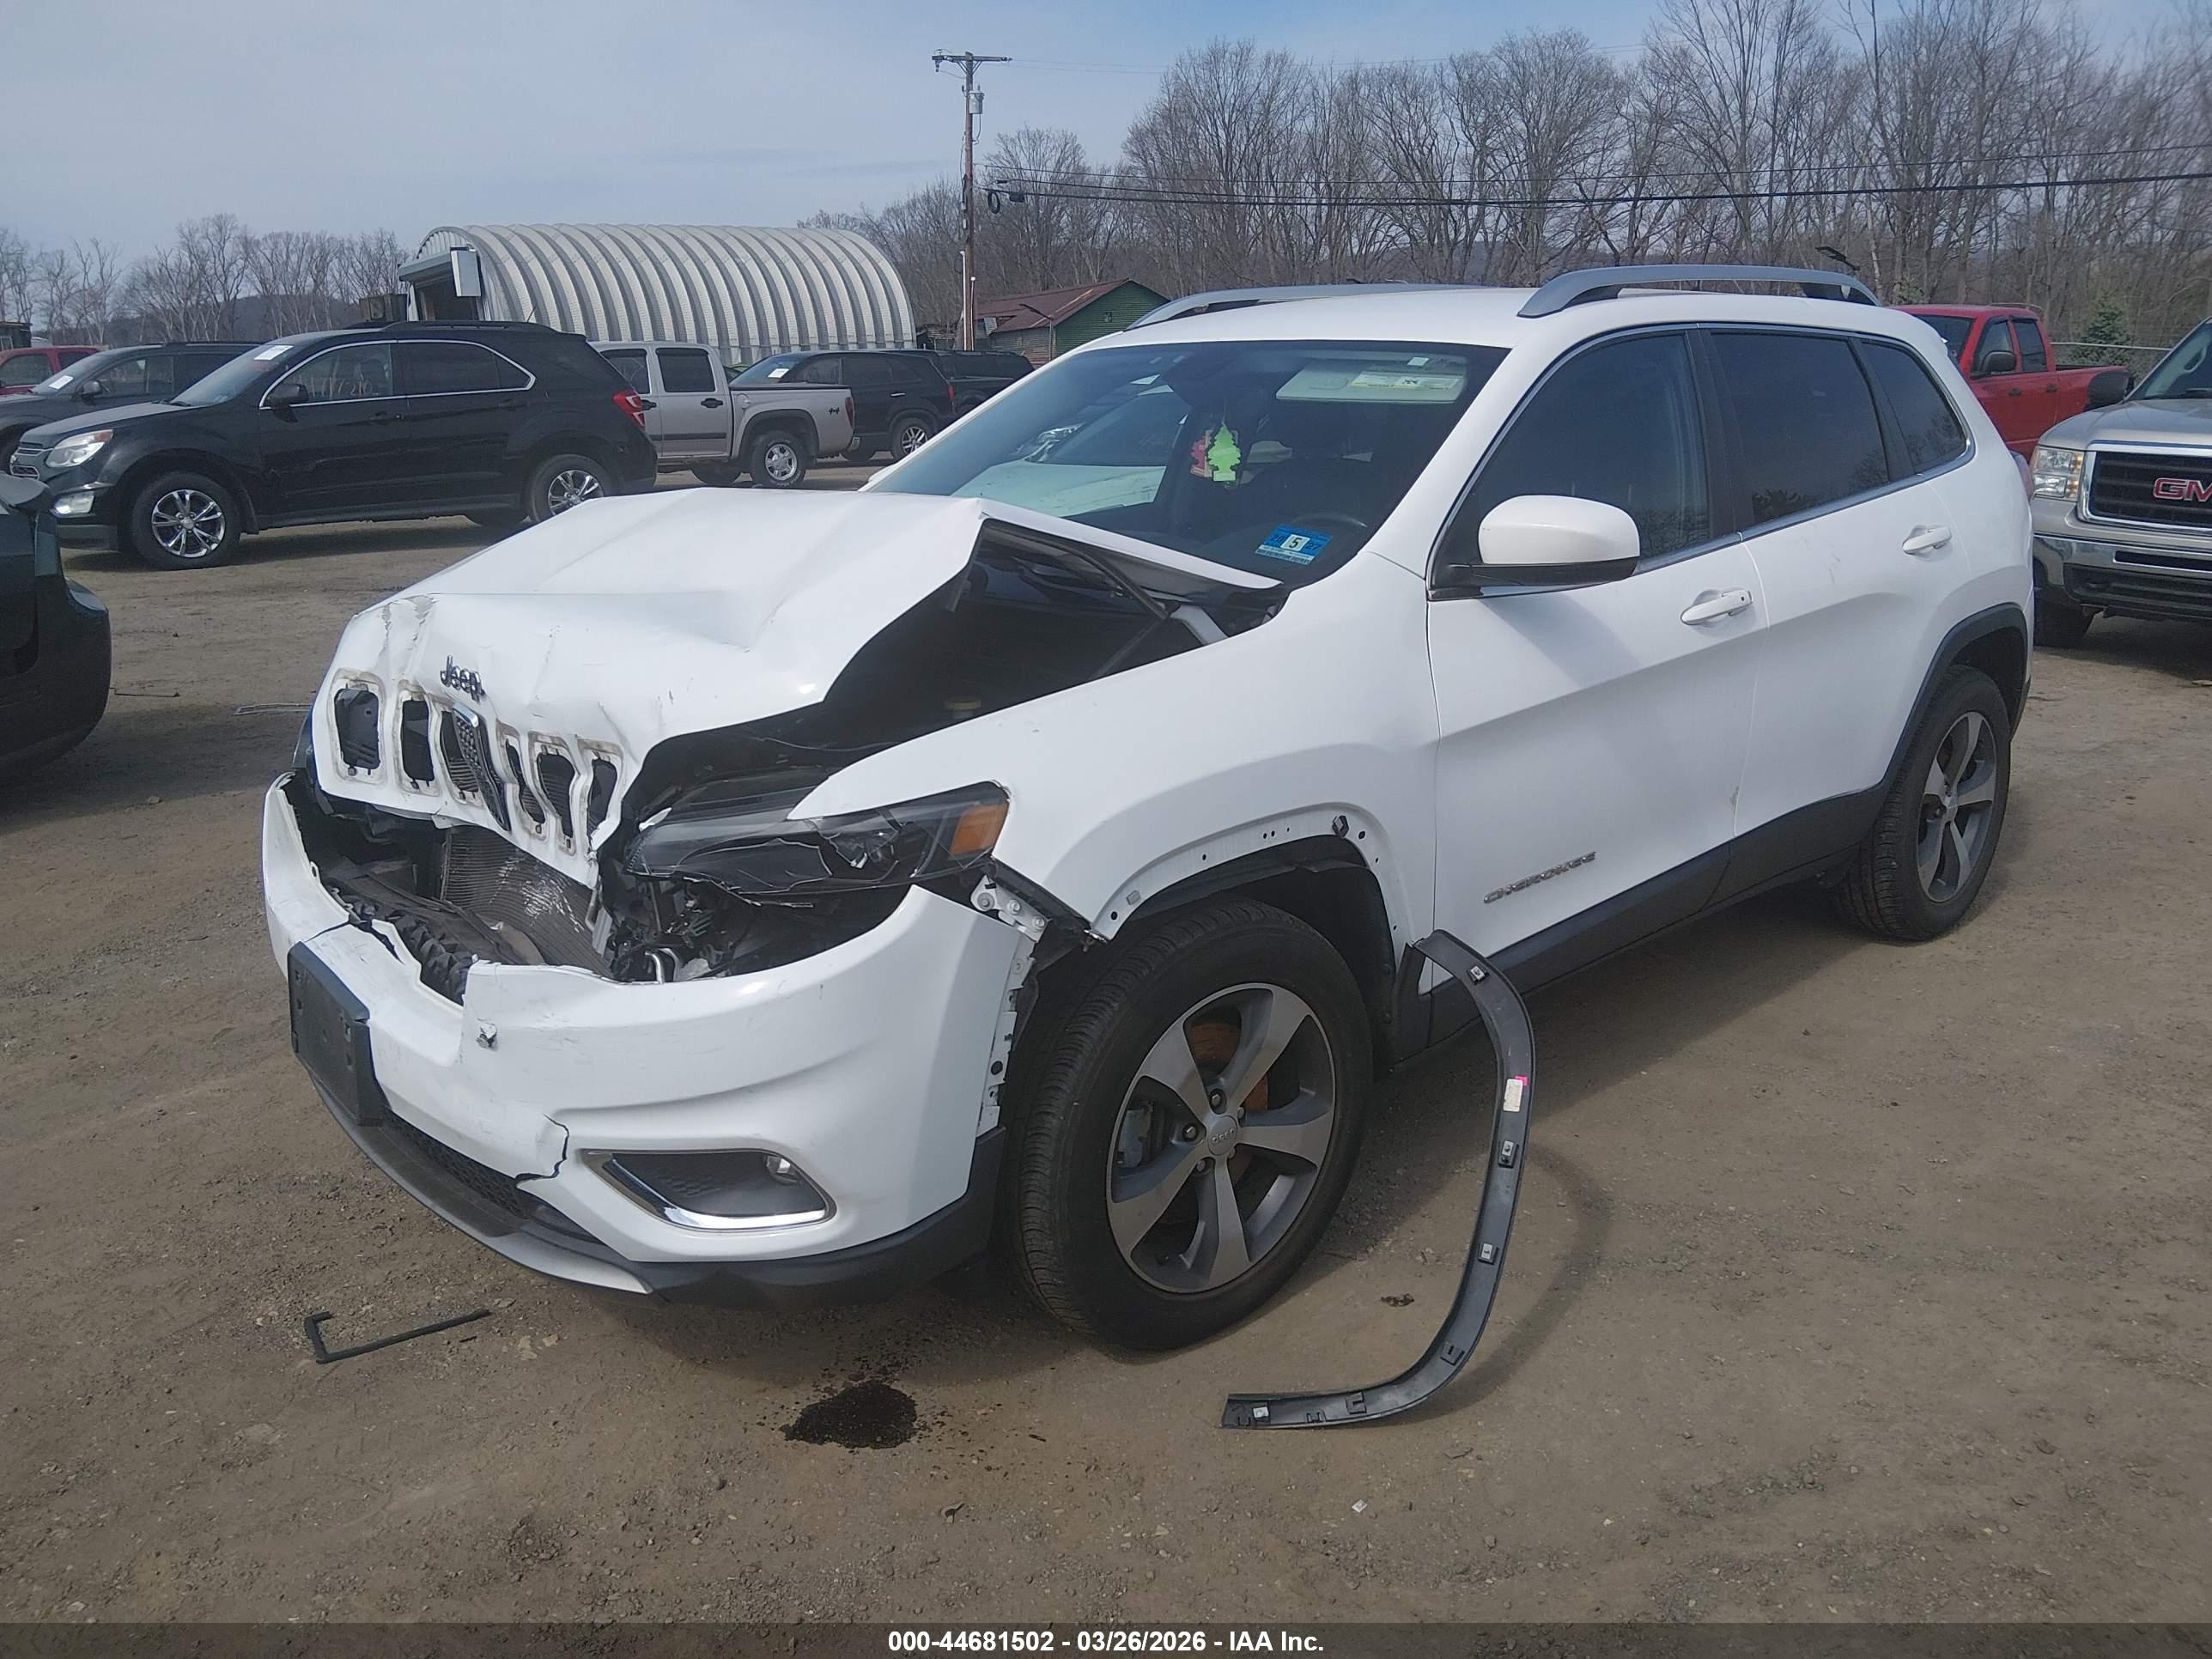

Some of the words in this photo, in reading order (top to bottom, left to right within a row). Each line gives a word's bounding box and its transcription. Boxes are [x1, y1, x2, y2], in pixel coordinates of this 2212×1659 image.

[1289, 538, 1302, 549] 5
[440, 654, 483, 702] Jeep
[1484, 851, 1597, 904] CHEROKEE
